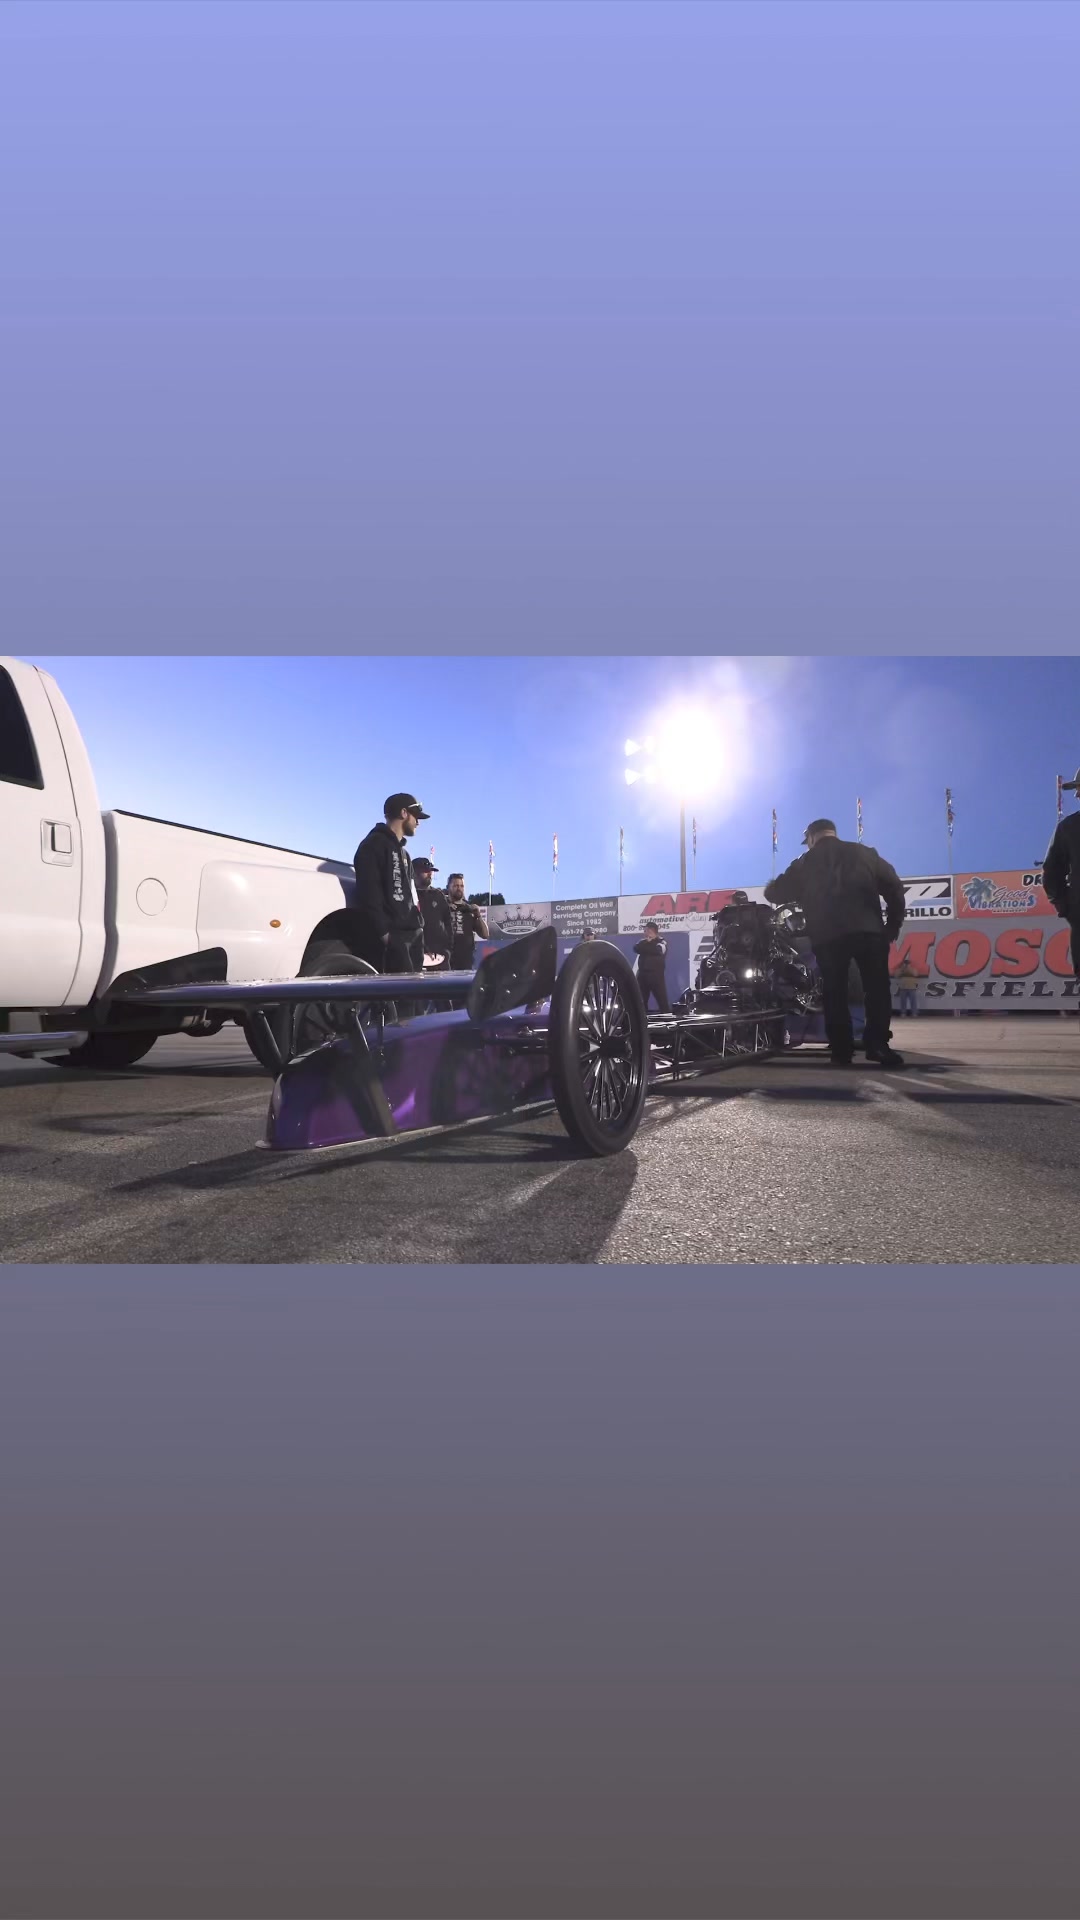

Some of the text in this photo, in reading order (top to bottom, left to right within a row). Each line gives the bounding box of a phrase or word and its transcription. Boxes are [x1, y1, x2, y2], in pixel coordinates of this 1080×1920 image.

[992, 886, 1032, 903] Good
[555, 903, 587, 912] Complete
[968, 895, 1034, 909] VIBRATIONS
[553, 910, 617, 919] Servicing Company
[640, 915, 684, 924] automotive
[894, 981, 1080, 997] SFIELD
